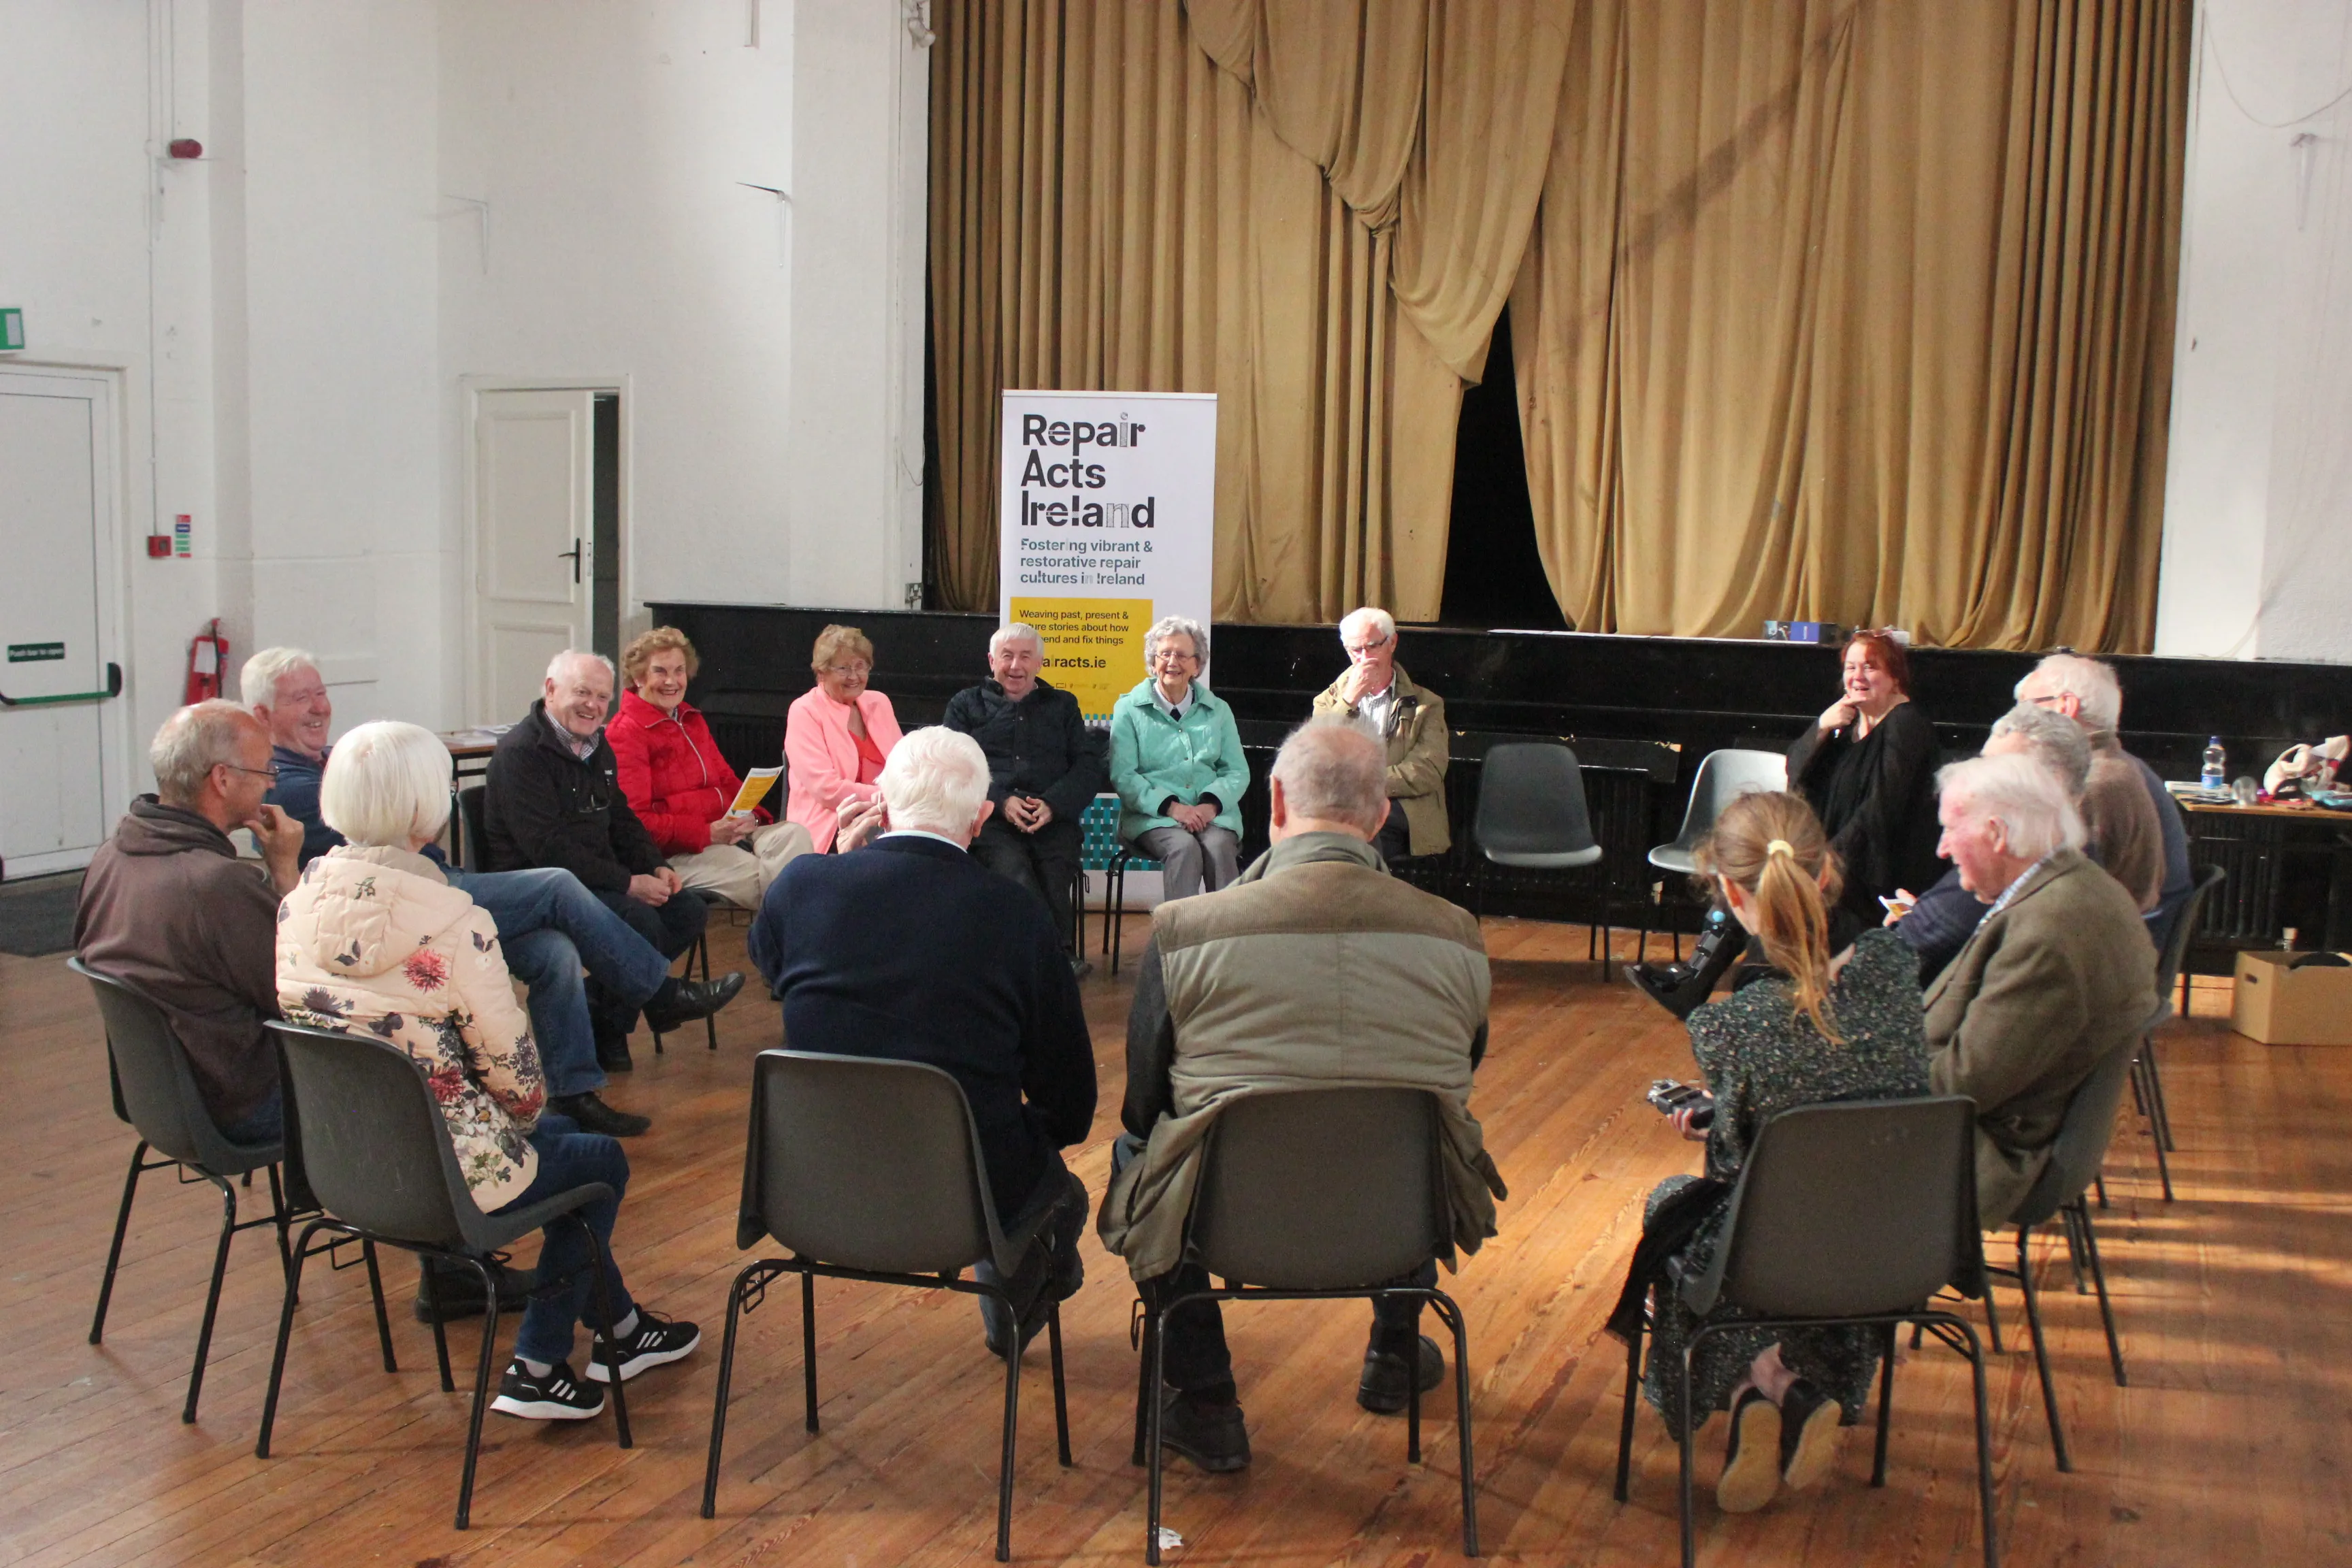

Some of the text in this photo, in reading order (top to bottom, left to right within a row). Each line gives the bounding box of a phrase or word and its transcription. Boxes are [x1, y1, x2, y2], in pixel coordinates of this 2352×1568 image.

[1023, 412, 1146, 457] Repair
[1021, 449, 1106, 489] Acts
[1021, 538, 1153, 554] Fostering vibrant &
[1020, 556, 1141, 572] restorative repair
[1020, 570, 1078, 584] cultures
[1081, 572, 1094, 584] in
[1019, 610, 1058, 620] Weaving
[1061, 611, 1083, 620] past,
[1085, 611, 1120, 620] present
[1049, 623, 1079, 631] stories
[1081, 623, 1107, 632] about
[1109, 623, 1129, 632] how
[1082, 636, 1093, 644] fix
[1096, 636, 1124, 646] things
